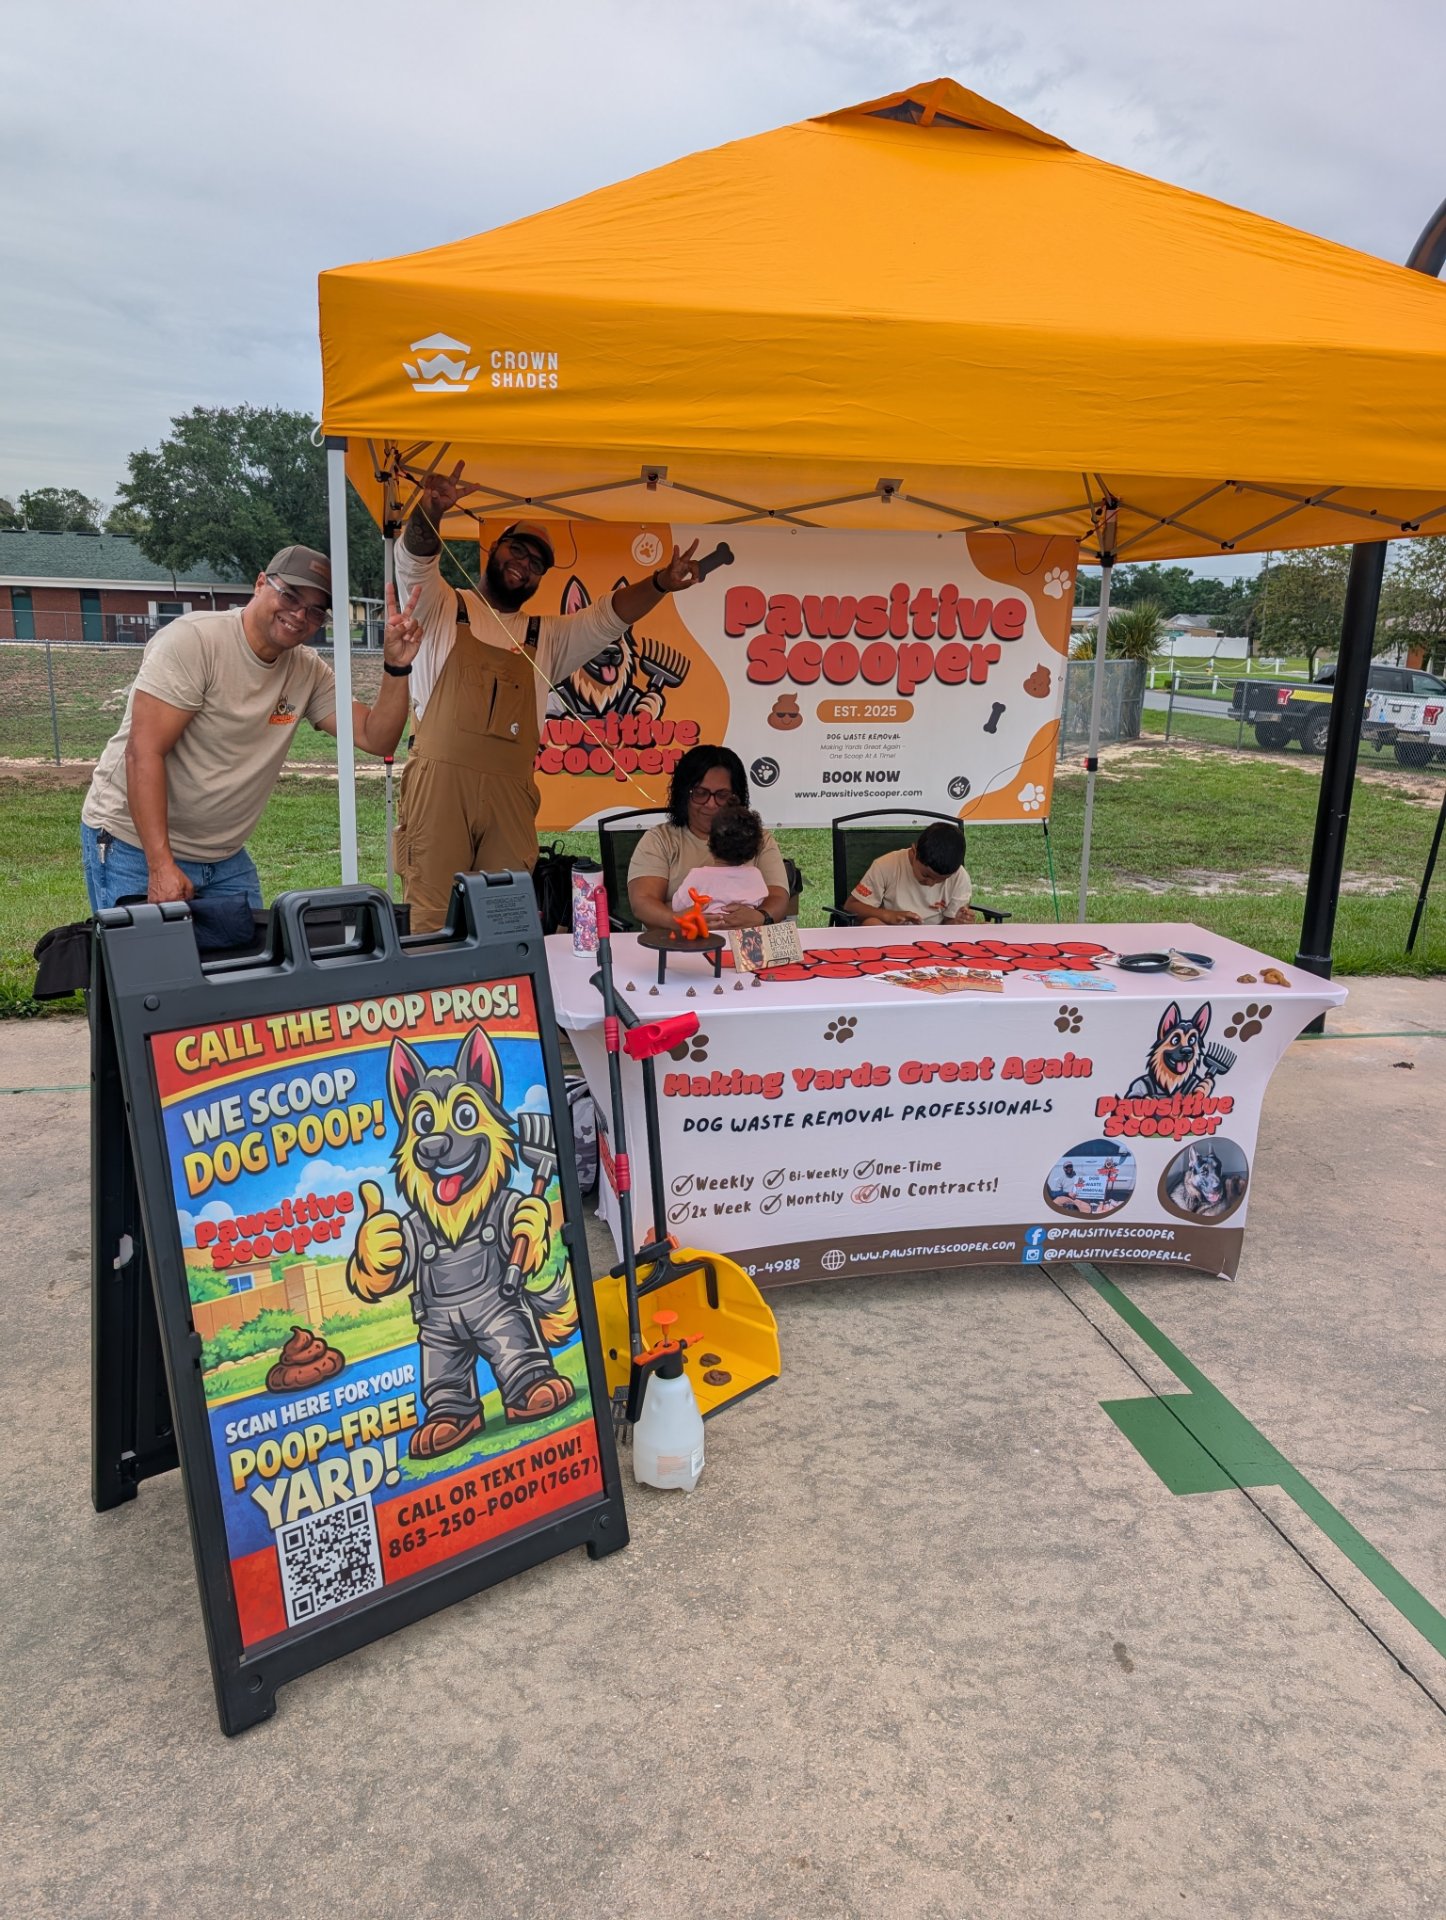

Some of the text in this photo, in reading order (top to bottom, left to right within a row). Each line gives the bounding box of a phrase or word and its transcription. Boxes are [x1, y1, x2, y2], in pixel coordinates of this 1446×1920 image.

[491, 350, 558, 370] CROWN
[491, 372, 558, 389] SHADES
[724, 582, 1027, 641] Pawsitive
[746, 633, 1002, 697] Scooper
[833, 705, 897, 718] EST. 2025
[540, 711, 700, 746] wsitive
[843, 733, 866, 741] WASTE
[883, 743, 901, 751] Again
[534, 747, 684, 781] cooper
[822, 770, 901, 783] BOOK NOW
[795, 789, 923, 799] www.PawsitiveScooper.com
[769, 935, 795, 948] HOME
[175, 984, 520, 1073] CALL THE POOP PROS!
[663, 1052, 1093, 1099] Making Yards Great Again
[182, 1068, 356, 1146] WE SCOOP
[683, 1098, 1053, 1133] DOG WASTE REMOVAL PROFESSIONALS
[1095, 1090, 1234, 1117] Pawsitive
[1103, 1115, 1222, 1141] Scooper
[183, 1100, 387, 1197] DOG POOP!
[789, 1167, 850, 1182] Bi-Weekly
[876, 1160, 942, 1175] One-Time
[695, 1174, 754, 1191] Weekly
[879, 1177, 999, 1199] No Contracts!
[691, 1201, 752, 1219] 2x Week
[786, 1191, 844, 1207] Monthly
[195, 1191, 354, 1249] Pawsitive
[211, 1216, 345, 1270] Scooper
[1047, 1228, 1175, 1241] @PAWSITIVESCOOPER
[850, 1240, 1016, 1262] WWW.PAWSITIVESCOOPER.COM
[1043, 1248, 1191, 1262] @PAWSITIVESCOOPERLLC
[225, 1364, 416, 1444] SCAN HERE FOR YOUR
[229, 1392, 418, 1492] POOP-FREE
[251, 1437, 401, 1529] YARD!
[397, 1436, 583, 1527] CALL OR TEXT NOW!
